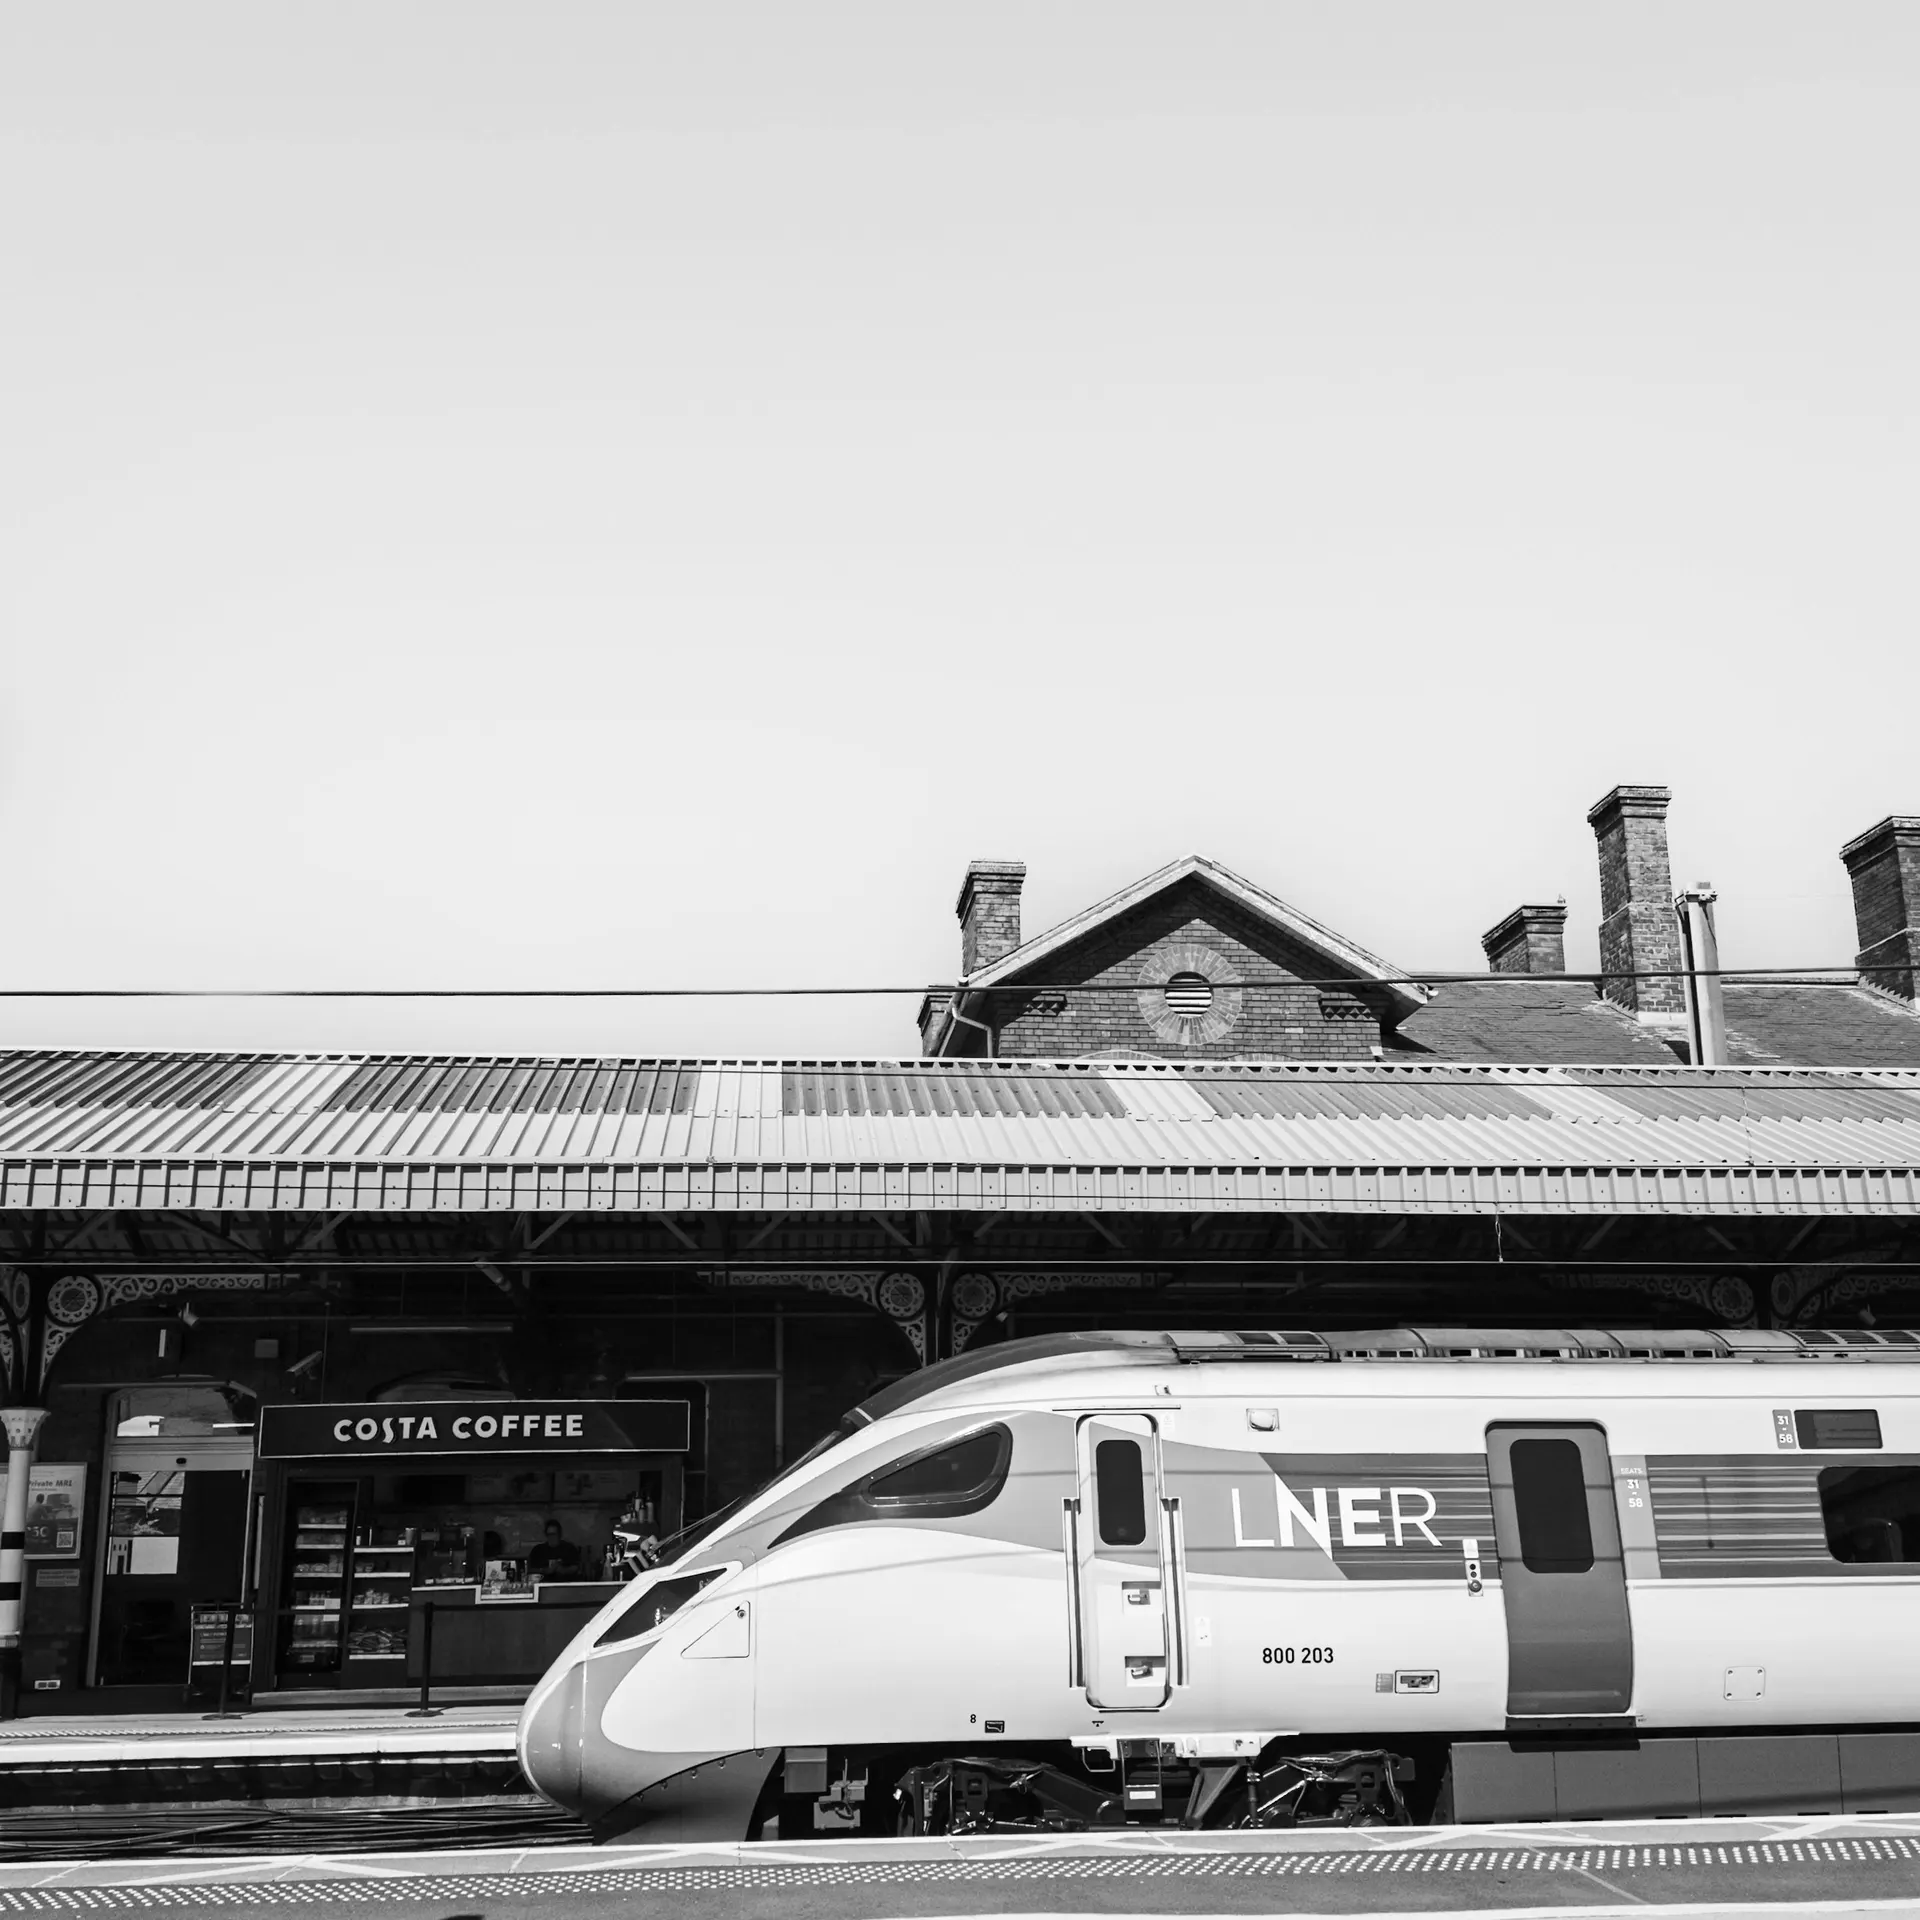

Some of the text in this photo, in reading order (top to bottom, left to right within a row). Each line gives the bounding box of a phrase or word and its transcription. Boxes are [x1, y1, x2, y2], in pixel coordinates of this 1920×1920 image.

[1777, 1415, 1789, 1425] 31
[333, 1414, 584, 1443] COSTA COFFEE
[1779, 1433, 1794, 1444] 58
[1620, 1467, 1643, 1475] SEATS
[55, 1479, 73, 1487] MRI
[1626, 1479, 1640, 1489] 31
[1628, 1497, 1643, 1508] 58
[1231, 1473, 1443, 1560] LNER
[1262, 1647, 1334, 1664] 800 203
[970, 1713, 977, 1724] 8
